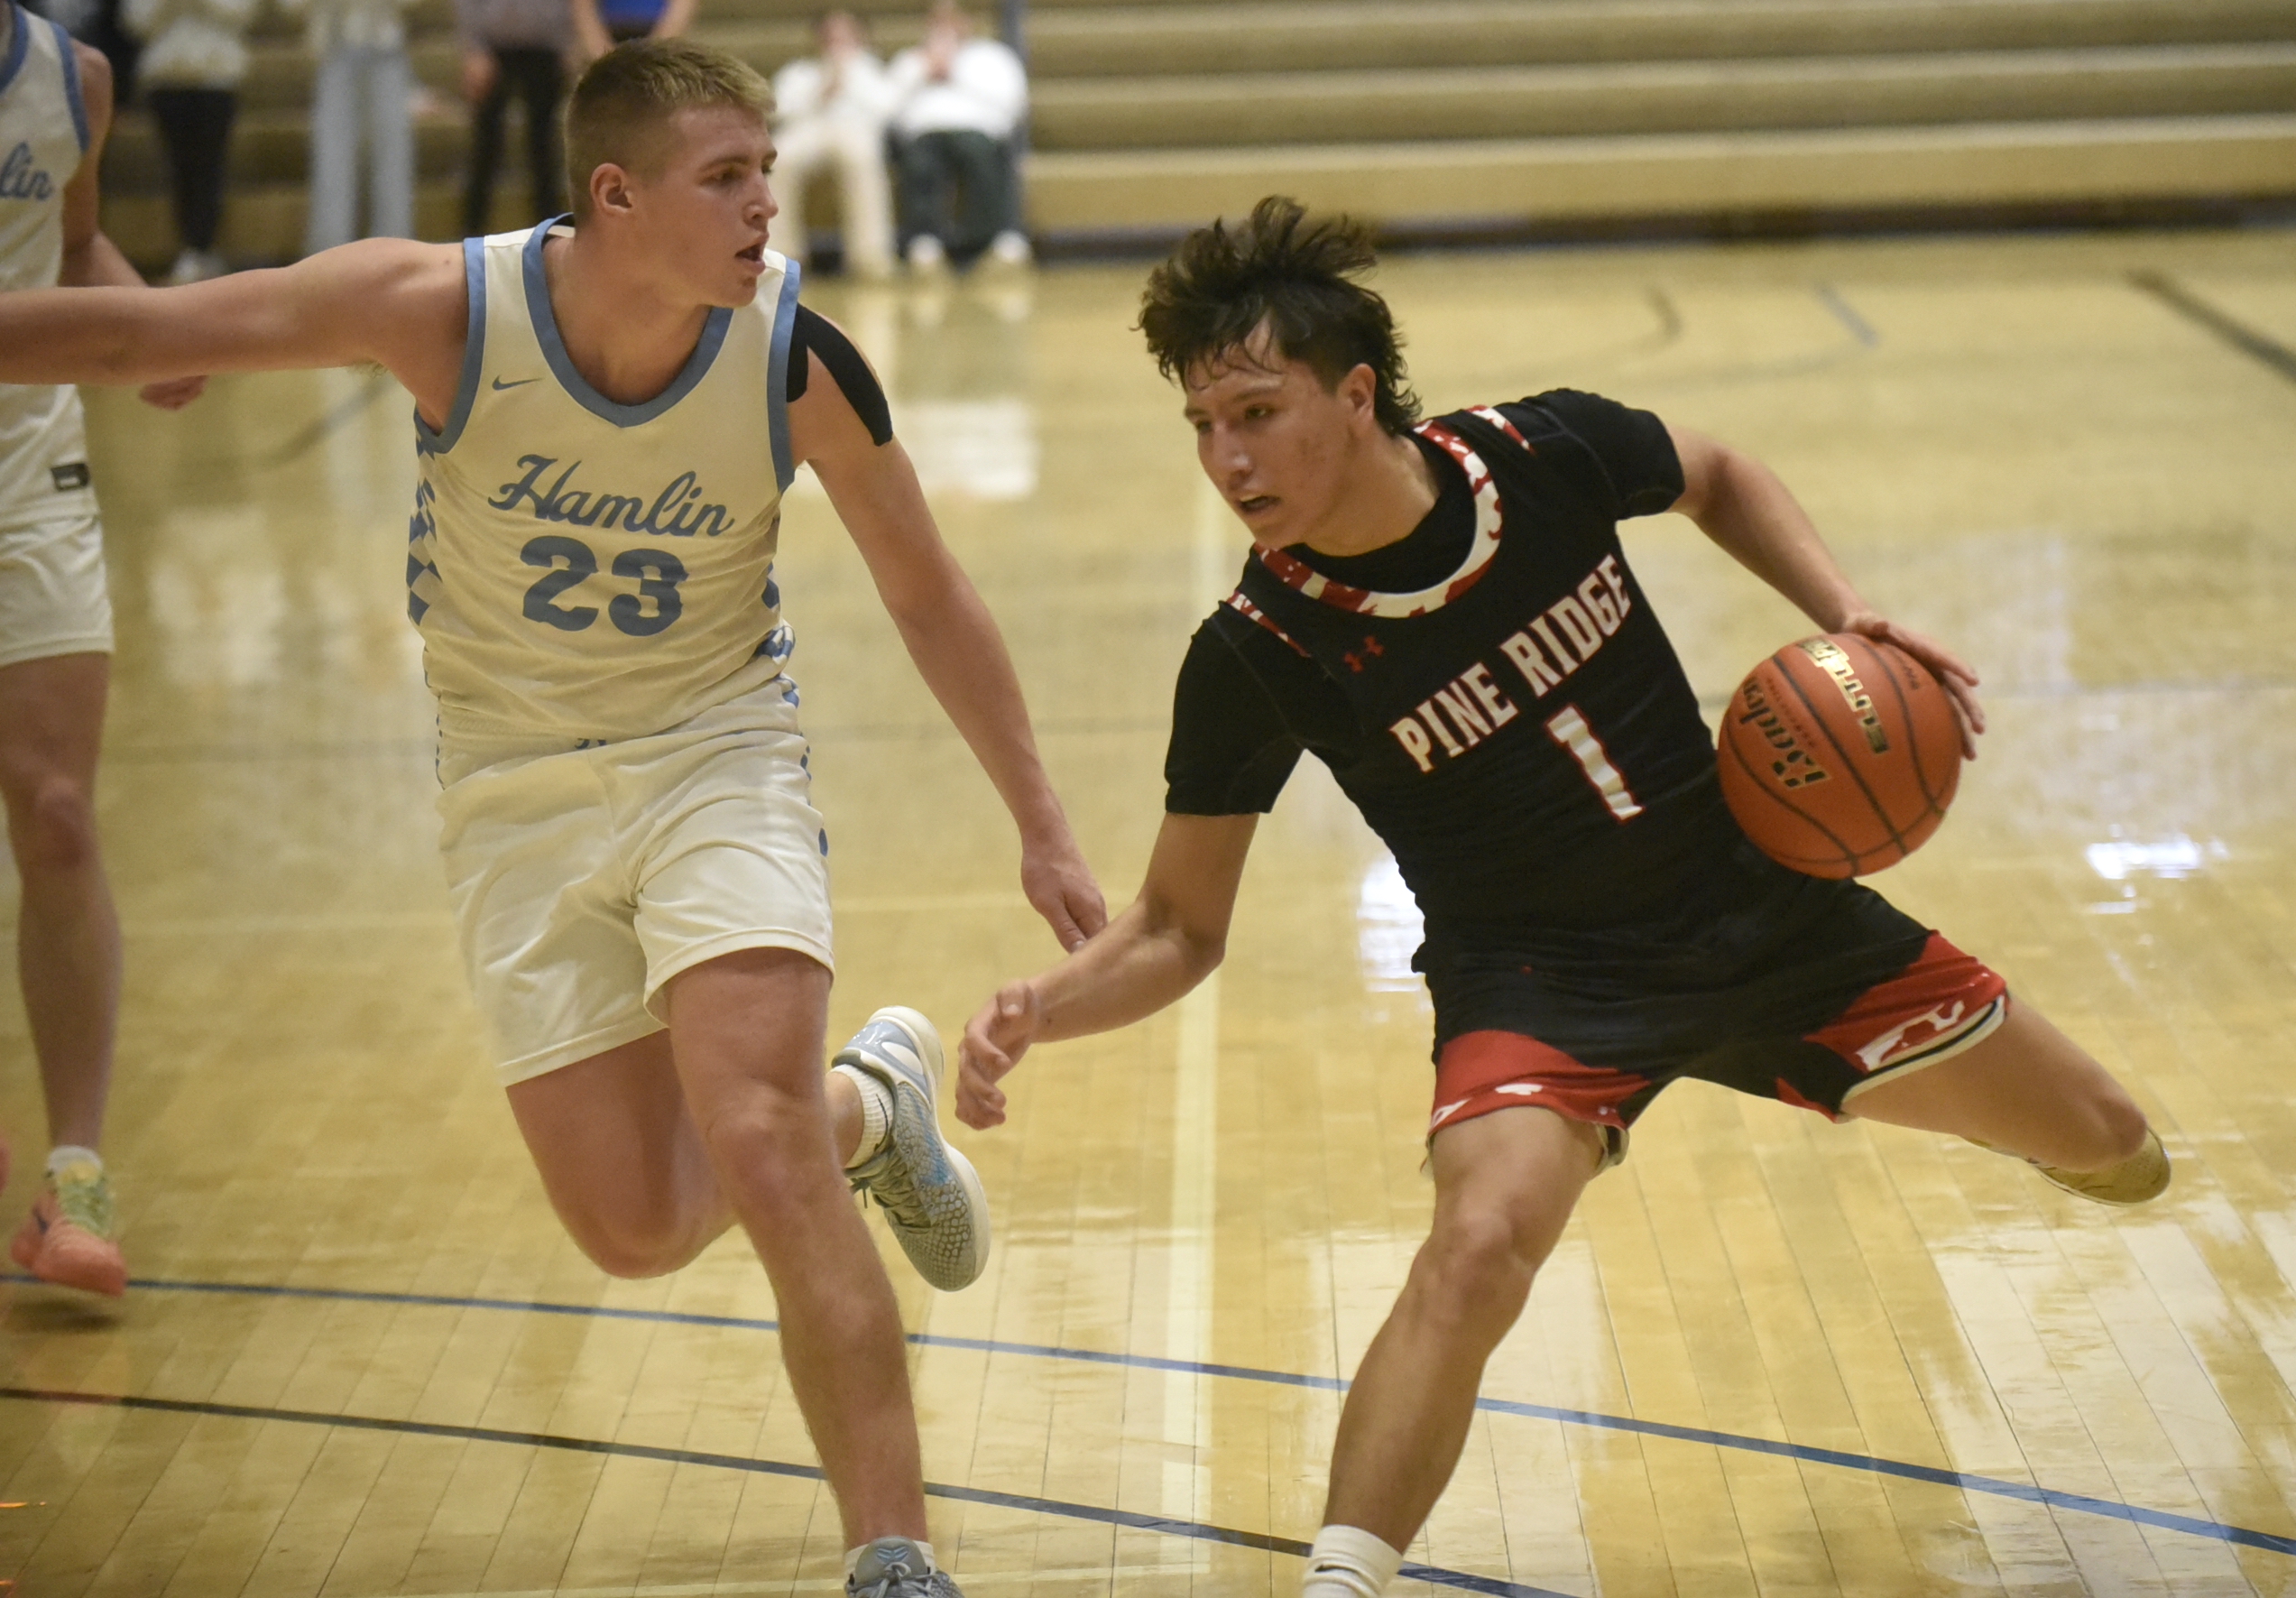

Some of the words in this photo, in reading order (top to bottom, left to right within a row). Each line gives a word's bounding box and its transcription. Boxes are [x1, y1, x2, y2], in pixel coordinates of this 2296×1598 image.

[487, 454, 734, 537] Hamlin
[520, 535, 689, 636] 23
[1388, 661, 1520, 773] PINE
[1498, 552, 1631, 698] RIDGE
[1544, 701, 1646, 825] 1
